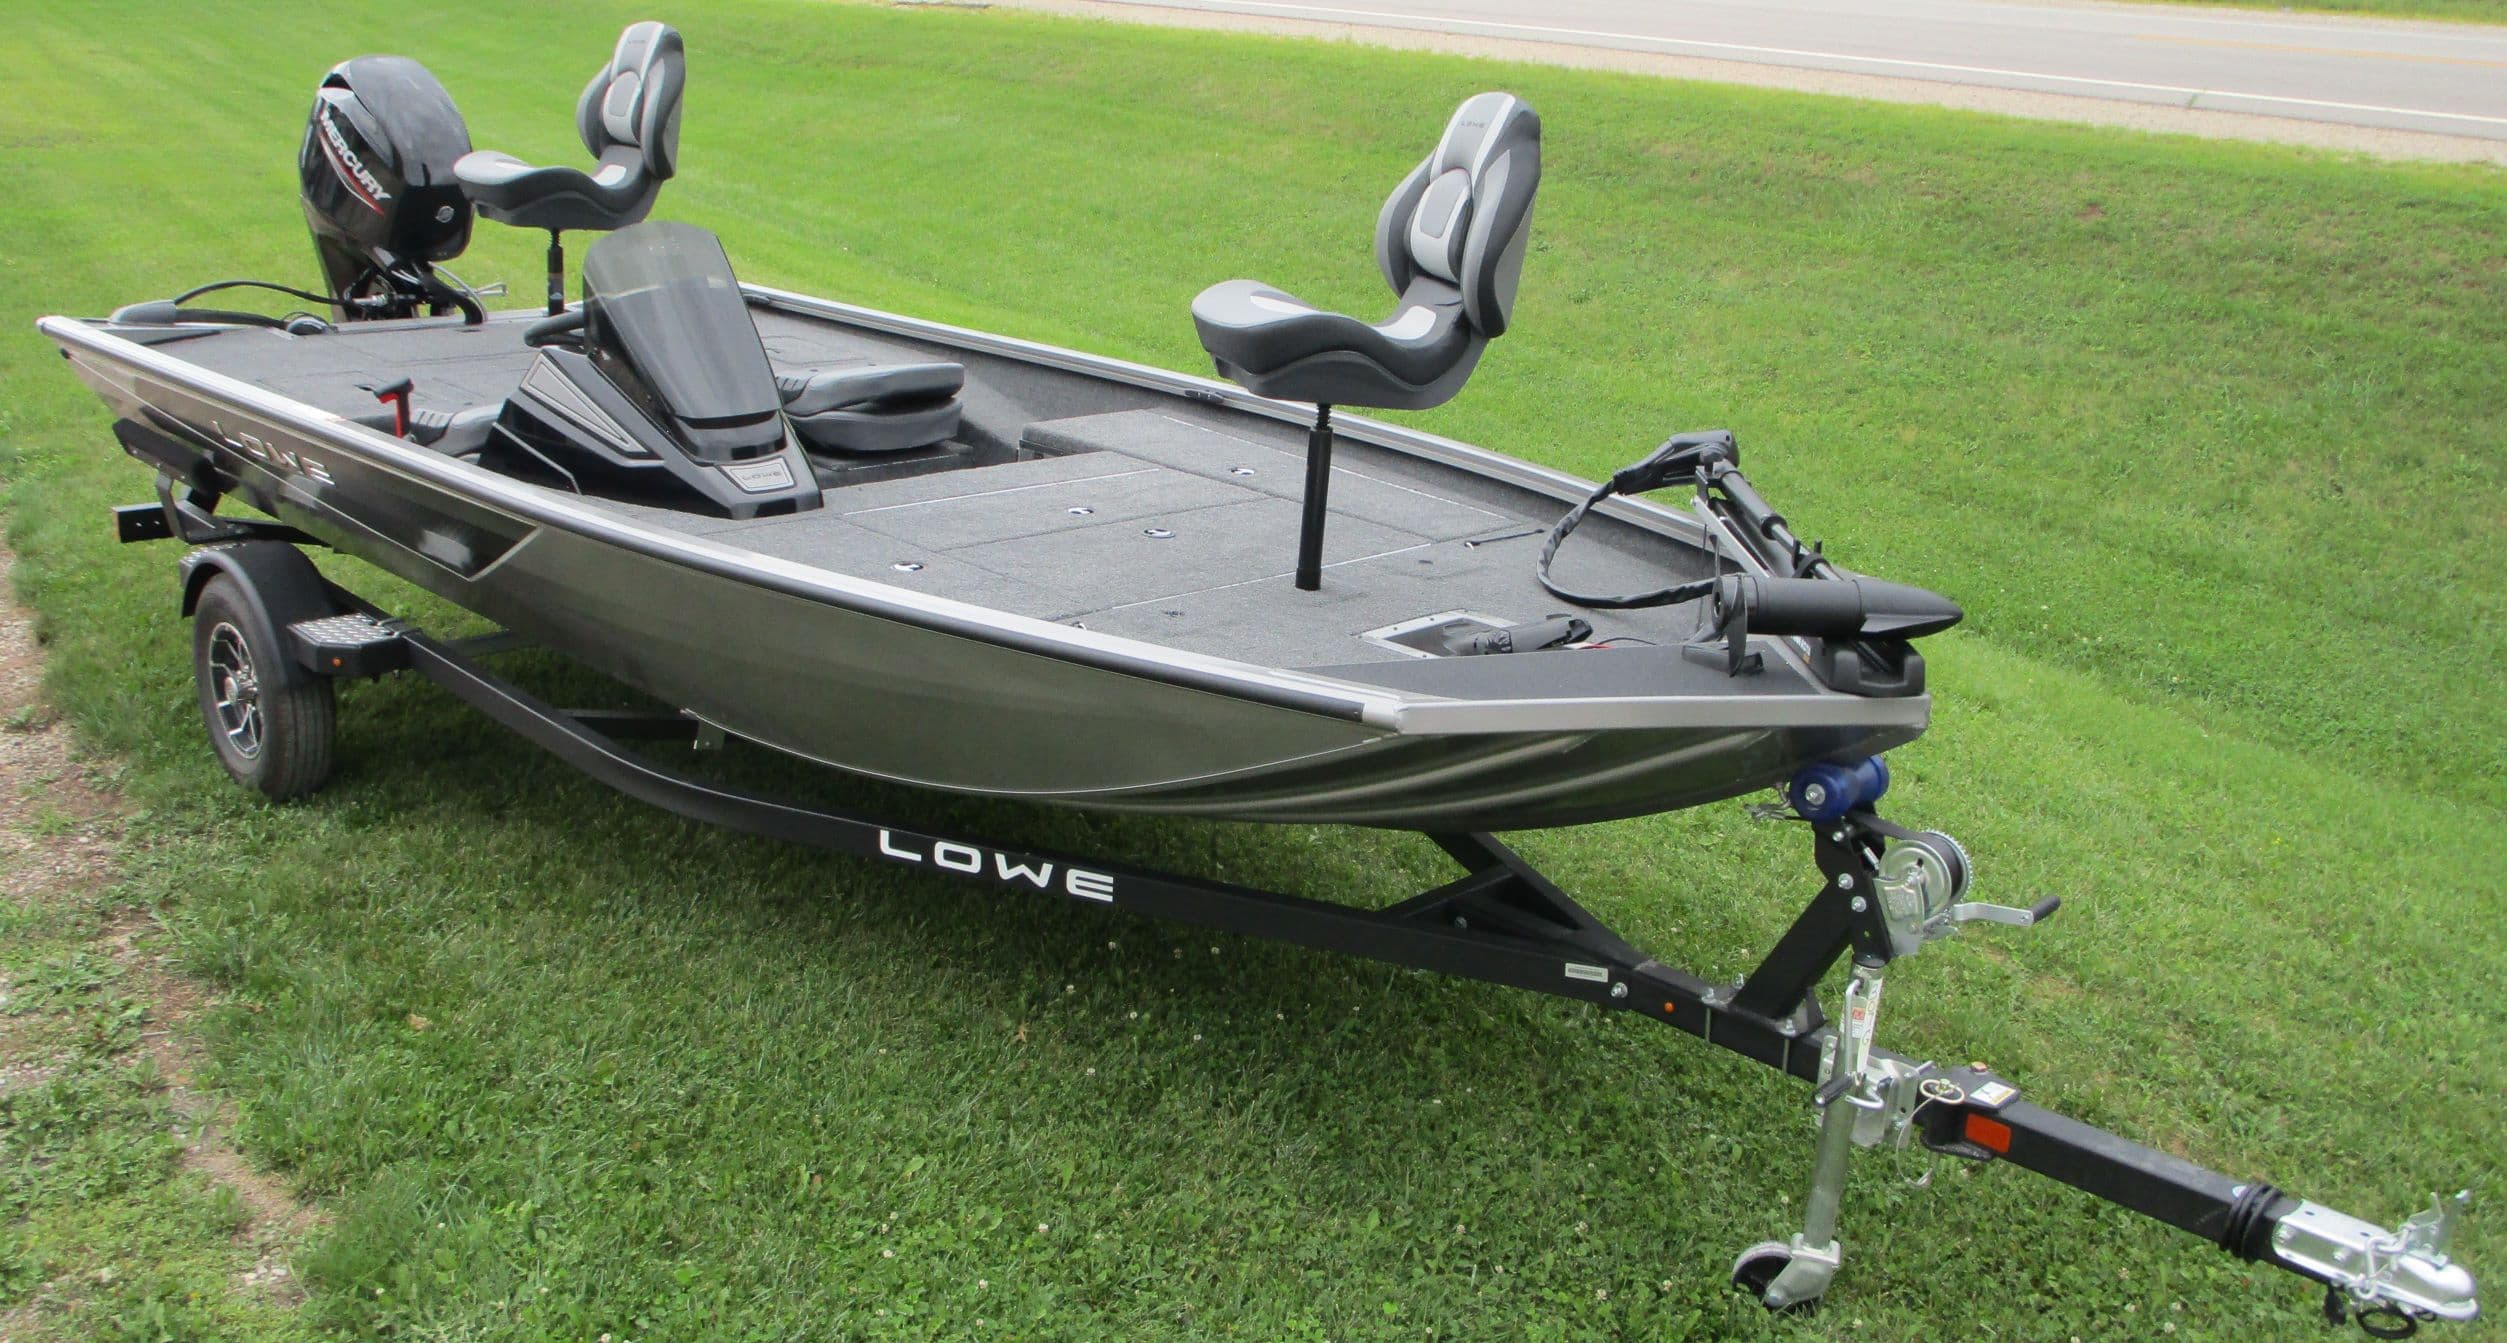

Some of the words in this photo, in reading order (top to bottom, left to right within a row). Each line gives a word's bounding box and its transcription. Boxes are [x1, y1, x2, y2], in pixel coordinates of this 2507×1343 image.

[319, 105, 392, 201] MERCURY
[208, 420, 336, 486] LOWE
[742, 471, 781, 480] LOWE
[879, 828, 1114, 903] LOWE
